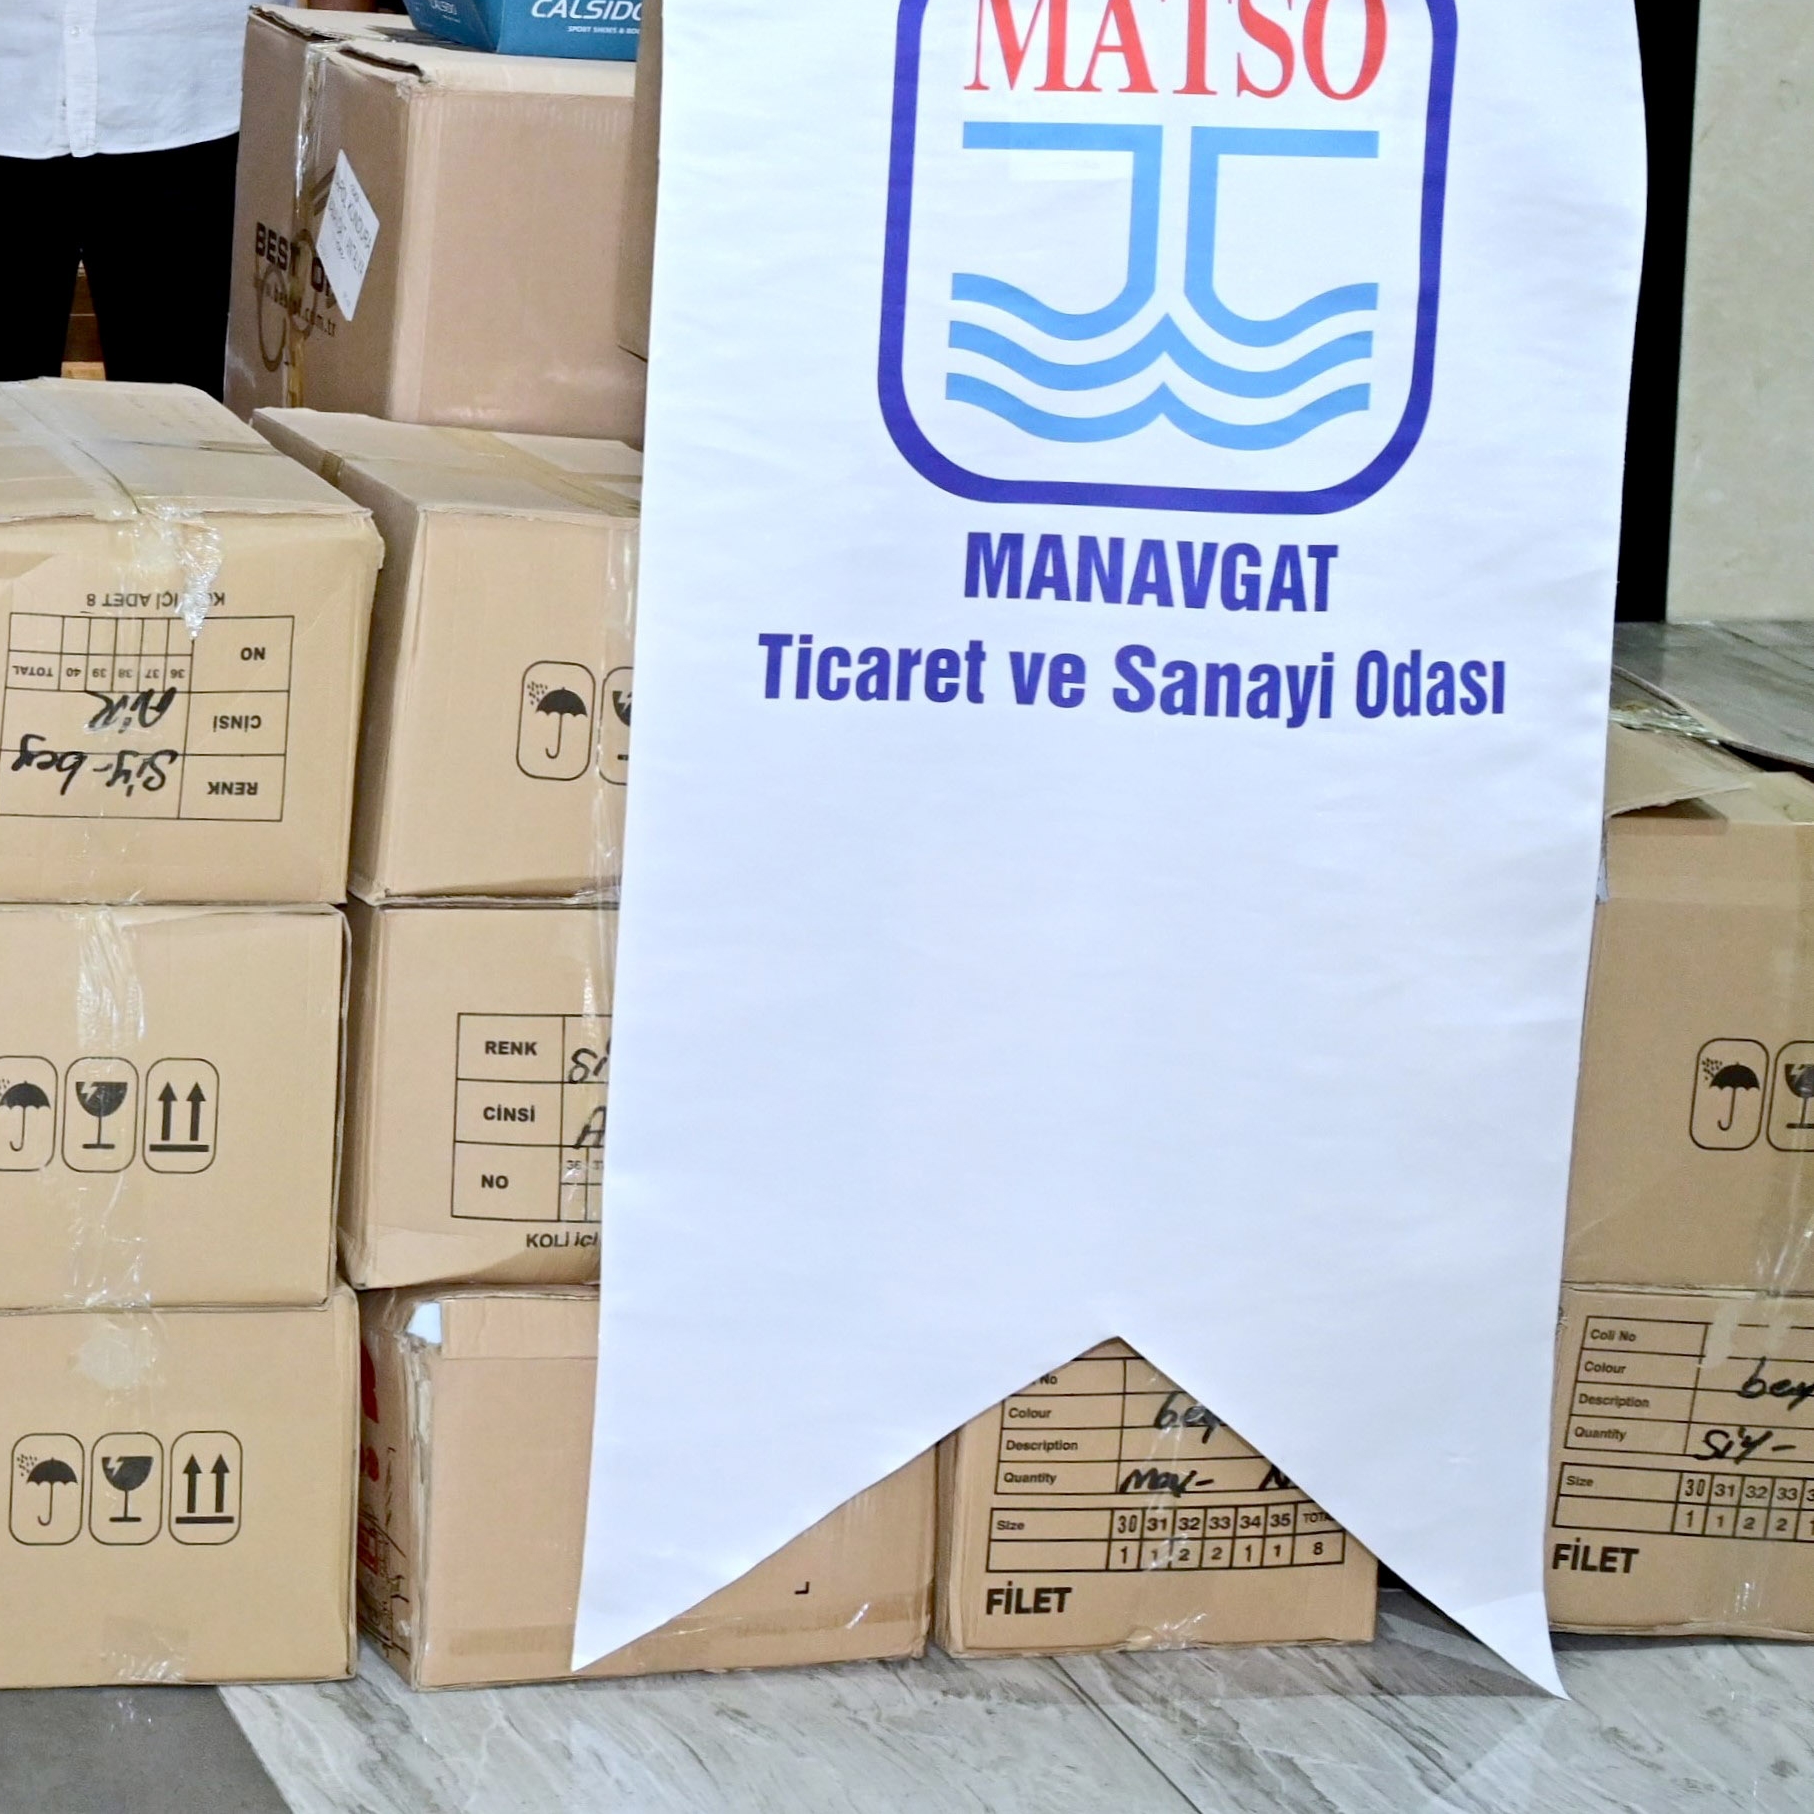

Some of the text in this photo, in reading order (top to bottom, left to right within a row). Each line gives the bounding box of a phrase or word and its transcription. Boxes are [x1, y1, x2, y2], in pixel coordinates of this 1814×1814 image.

[963, 531, 1339, 613] MANAVGAT
[86, 593, 96, 607] 8
[102, 593, 150, 607] ADET
[240, 647, 266, 661] NO
[14, 665, 53, 677] TOTAL
[66, 668, 81, 677] 40
[92, 668, 106, 678] 39
[144, 668, 160, 678] 37
[170, 668, 185, 678] 36
[757, 632, 1507, 730] Ticaret ve Sanayi Odası
[213, 715, 261, 733] CİNSİ
[208, 781, 258, 796] RENK
[485, 1041, 537, 1056] RENK
[483, 1104, 536, 1122] CİNSİ
[481, 1174, 509, 1189] NO
[1618, 1330, 1637, 1342] No
[1583, 1361, 1626, 1374] Colour
[1578, 1392, 1650, 1411] Description
[1008, 1407, 1052, 1420] Colour
[1574, 1426, 1627, 1442] Quantity
[1006, 1439, 1078, 1453] Description
[1004, 1472, 1057, 1485] Quantity
[1566, 1475, 1594, 1488] Size
[1684, 1478, 1706, 1497] 30
[1714, 1484, 1735, 1497] 31
[1745, 1486, 1768, 1499] 32
[1776, 1487, 1798, 1501] 33
[996, 1511, 1335, 1534] Size 30 31 32 33 34 35 TOTA
[1687, 1509, 1787, 1532] 1 1 2 2
[1121, 1545, 1129, 1564] 1
[1179, 1548, 1190, 1562] 2
[1211, 1547, 1223, 1560] 2
[1244, 1544, 1252, 1562] 1
[1274, 1544, 1282, 1558] 1
[1313, 1541, 1324, 1556] 8
[1552, 1537, 1640, 1574] FİLET
[986, 1580, 1072, 1615] FİLET
